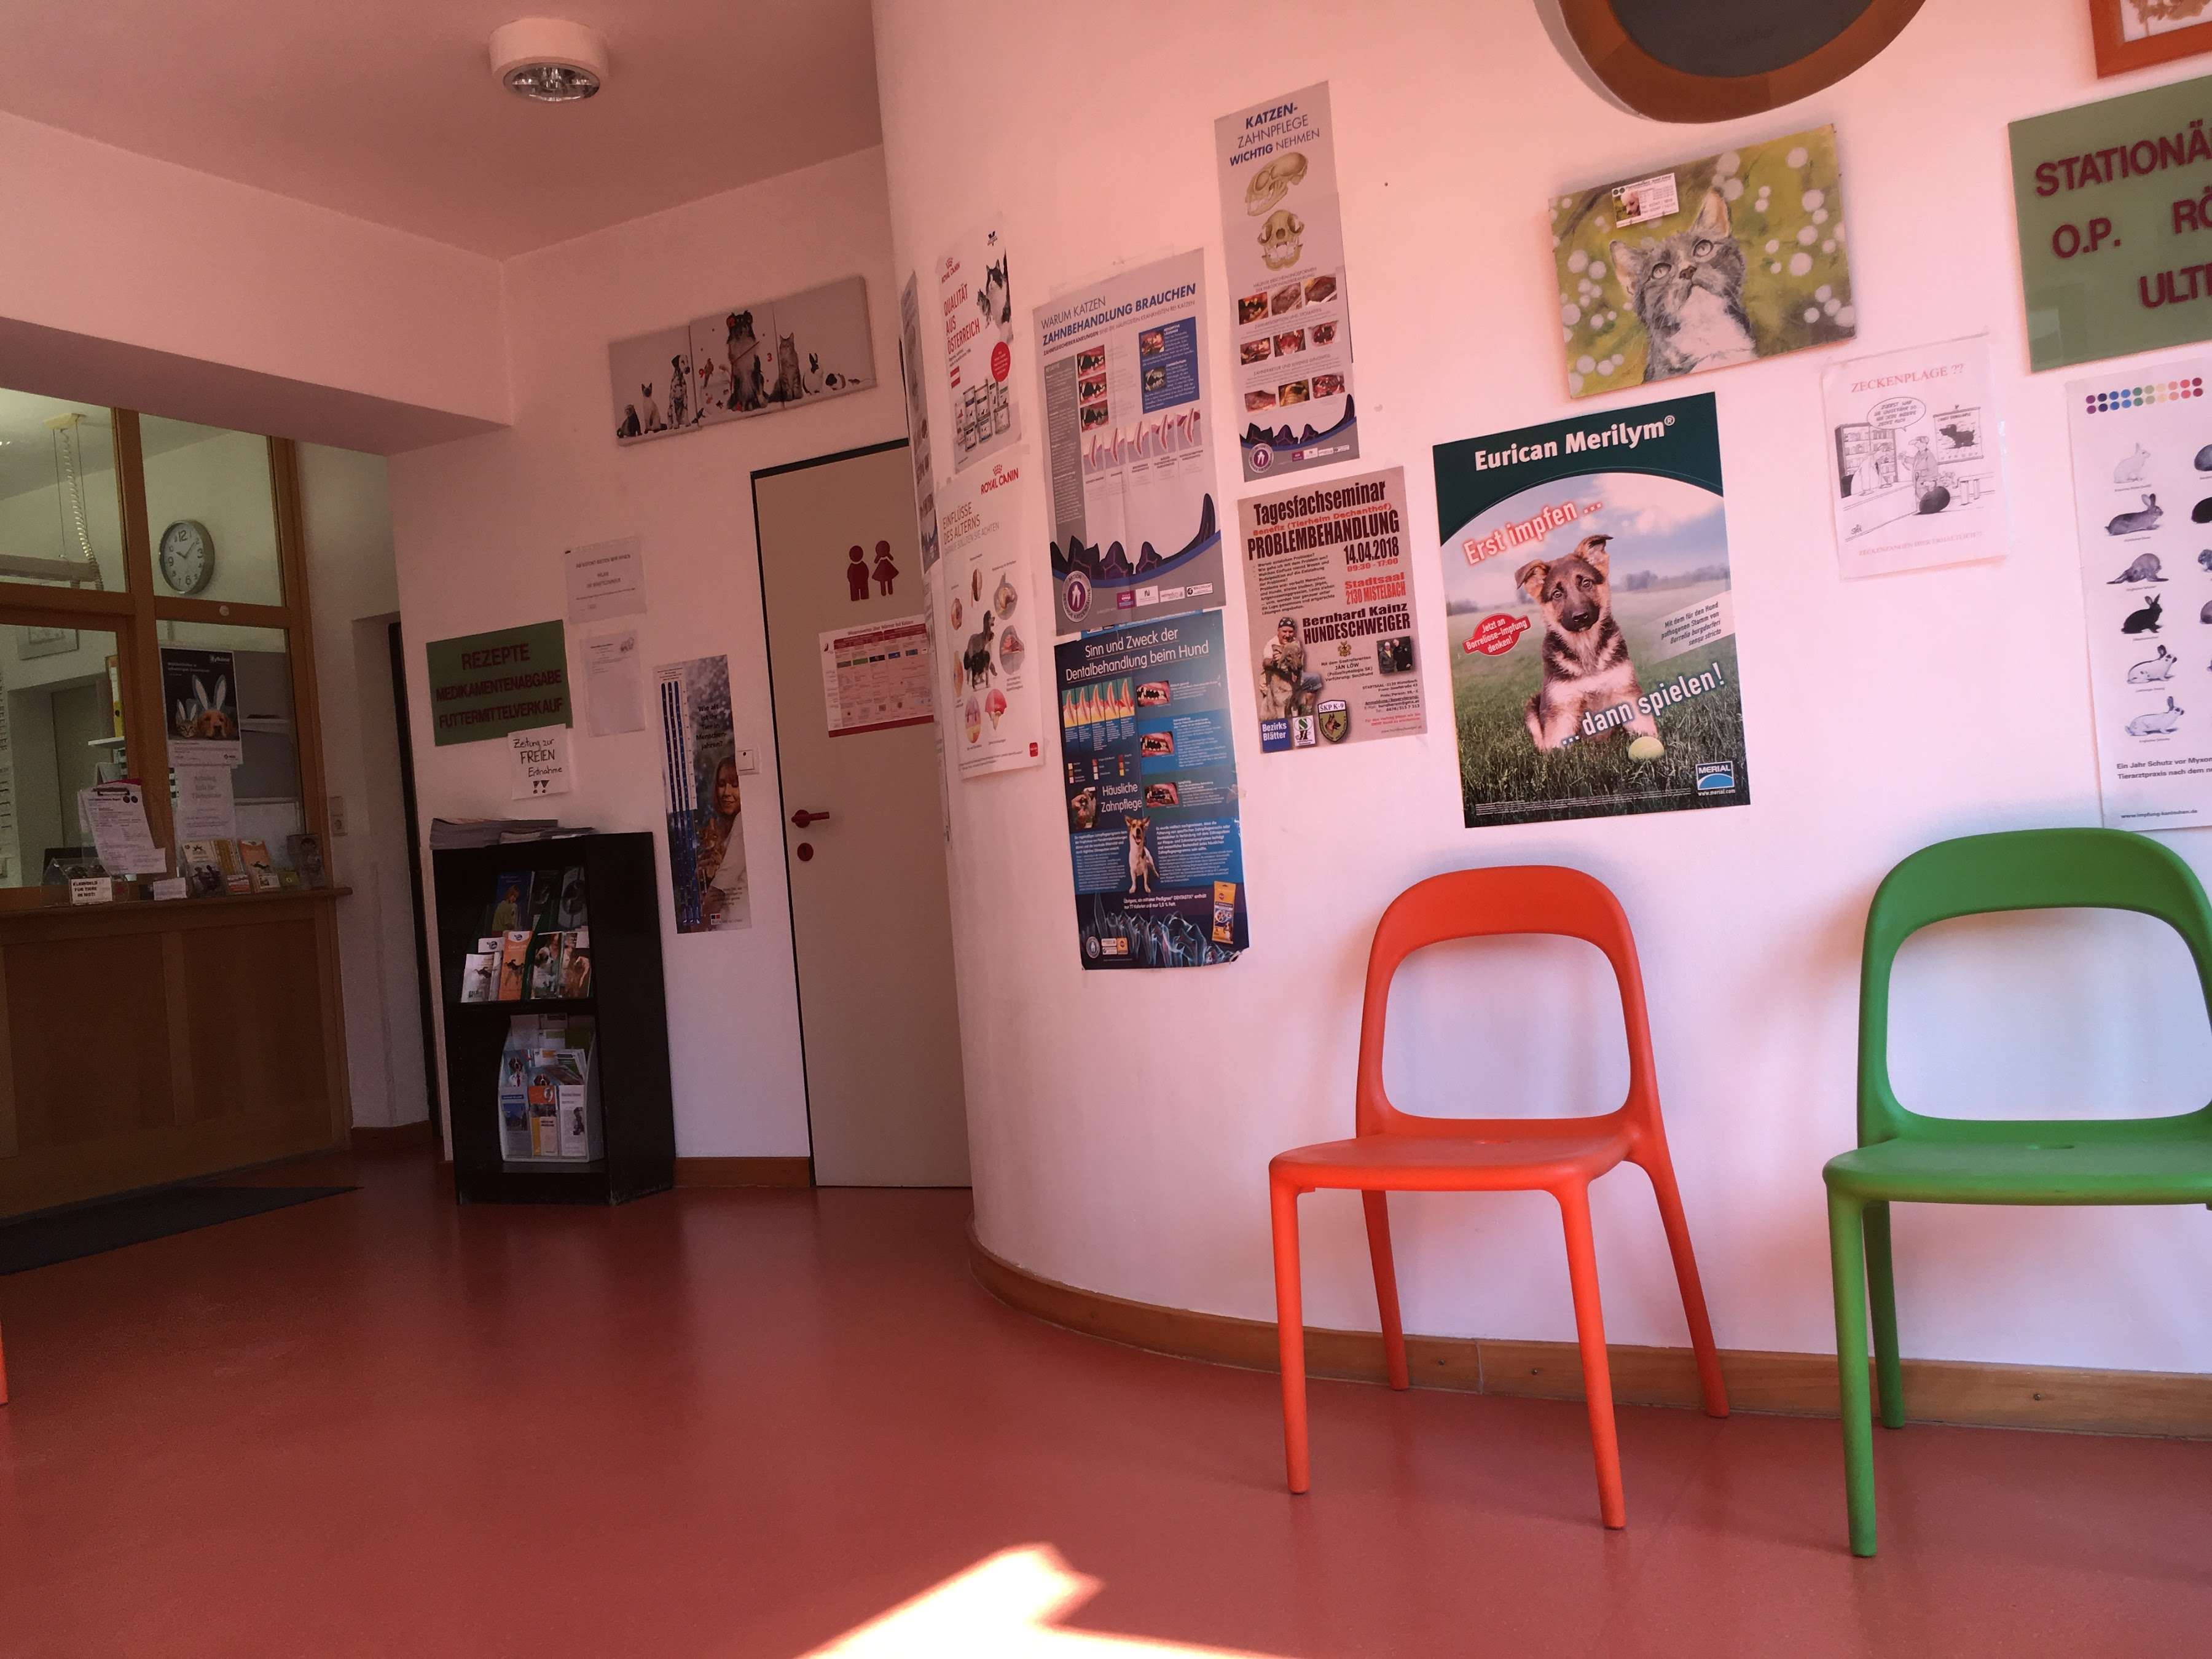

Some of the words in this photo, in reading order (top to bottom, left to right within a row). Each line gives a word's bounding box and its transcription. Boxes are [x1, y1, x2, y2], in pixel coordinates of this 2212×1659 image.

[1245, 103, 1298, 130] KATZEN-
[1237, 114, 1309, 149] ZAHNPFLEGE
[1230, 144, 1273, 167] WICHTIG
[1276, 128, 1320, 151] NEHMEN
[2034, 119, 2212, 197] STATIONÄ
[2051, 218, 2121, 259] O.P.
[944, 283, 968, 316] QUALITÄT
[2138, 262, 2212, 310] ULT
[946, 315, 957, 336] AUS
[1041, 309, 1072, 330] WARUM
[1073, 296, 1106, 317] KATZEN
[1043, 304, 1132, 347] ZAHNBEHANDLUNG
[1135, 283, 1196, 312] BRAUCHEN
[947, 318, 980, 355] ÖSTERREICH
[767, 353, 772, 362] 3
[1851, 366, 1948, 393] ZECKENPLAGE
[1474, 441, 1558, 472] Eurican
[980, 478, 998, 495] ROYAL
[998, 468, 1019, 486] CANIN
[943, 501, 972, 530] EINFLÜSSE
[1253, 481, 1386, 526] Tagesfachseminar
[943, 528, 953, 545] DES
[954, 514, 981, 538] ALTERNS
[1253, 525, 1285, 536] Benefiz
[1287, 515, 1330, 530] (Tierheim
[1333, 503, 1392, 520] Dechanthof)
[1463, 526, 1505, 565] Erst
[1506, 500, 1578, 546] impfen
[178, 530, 187, 542] 12
[1247, 509, 1400, 560] PROBLEMBEHANDLUNG
[1343, 536, 1400, 565] 14.04.2018
[1344, 571, 1405, 590] Stadtsaal
[1347, 563, 1371, 573] 09:30
[1346, 588, 1362, 605] 2130
[1364, 581, 1406, 601] MISTELBACH
[1302, 608, 1365, 627] Bernhard
[1369, 603, 1408, 617] Kainz
[1303, 613, 1411, 645] HUNDESCHWEIGER
[1482, 620, 1497, 633] Jetzt
[1497, 618, 1506, 627] an
[1665, 620, 1673, 629] Mit
[1695, 608, 1704, 617] den
[1705, 601, 1719, 613] Hund
[1691, 616, 1709, 627] Stamm
[1085, 644, 1105, 658] Sinn
[1106, 636, 1124, 653] und
[1126, 630, 1159, 649] Zweck
[1160, 627, 1178, 642] der
[1465, 619, 1528, 650] Borreliose-Impfung
[1488, 635, 1513, 653] denken!
[1704, 628, 1722, 640] stricto
[461, 643, 531, 670] REZEPTE
[1065, 653, 1148, 682] Dentalbehandlung
[1150, 647, 1176, 664] beim
[1179, 640, 1209, 657] Hund
[436, 669, 562, 702] MEDIKAMENTENABGABE
[1582, 703, 1633, 737] dann
[1638, 662, 1725, 717] spielen!
[439, 697, 563, 729] FUTTERMITTELVERKAUF
[1262, 722, 1287, 732] Bezirks
[512, 737, 541, 750] Zeitung
[1263, 731, 1286, 741] Blätter
[520, 749, 555, 764] FREIEN
[1698, 764, 1731, 774] MERIAL
[1102, 782, 1138, 797] Häusliche
[2117, 771, 2167, 780] Tierarztpraxis
[1100, 799, 1142, 814] Zahnpflege
